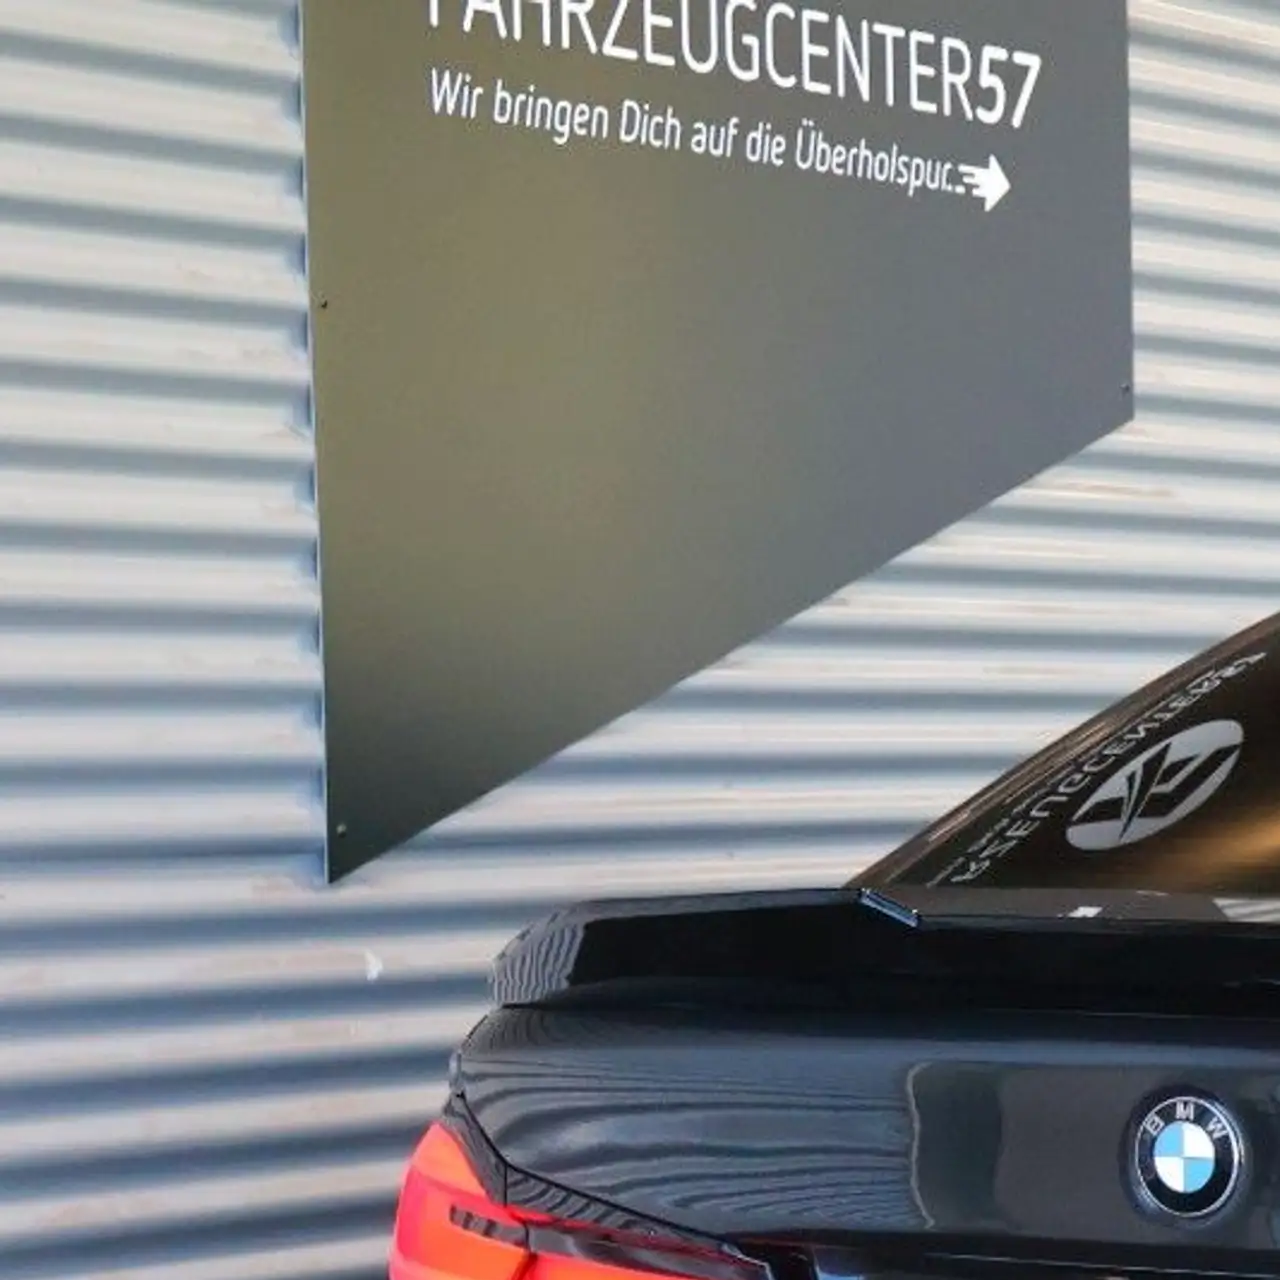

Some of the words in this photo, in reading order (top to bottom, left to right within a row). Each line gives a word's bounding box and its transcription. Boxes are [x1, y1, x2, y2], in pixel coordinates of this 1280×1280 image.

[431, 66, 484, 119] Wir
[492, 78, 609, 145] bringen
[618, 99, 682, 151] Dich
[690, 116, 740, 159] auf
[745, 121, 786, 168] die
[1141, 1100, 1228, 1141] BMW
